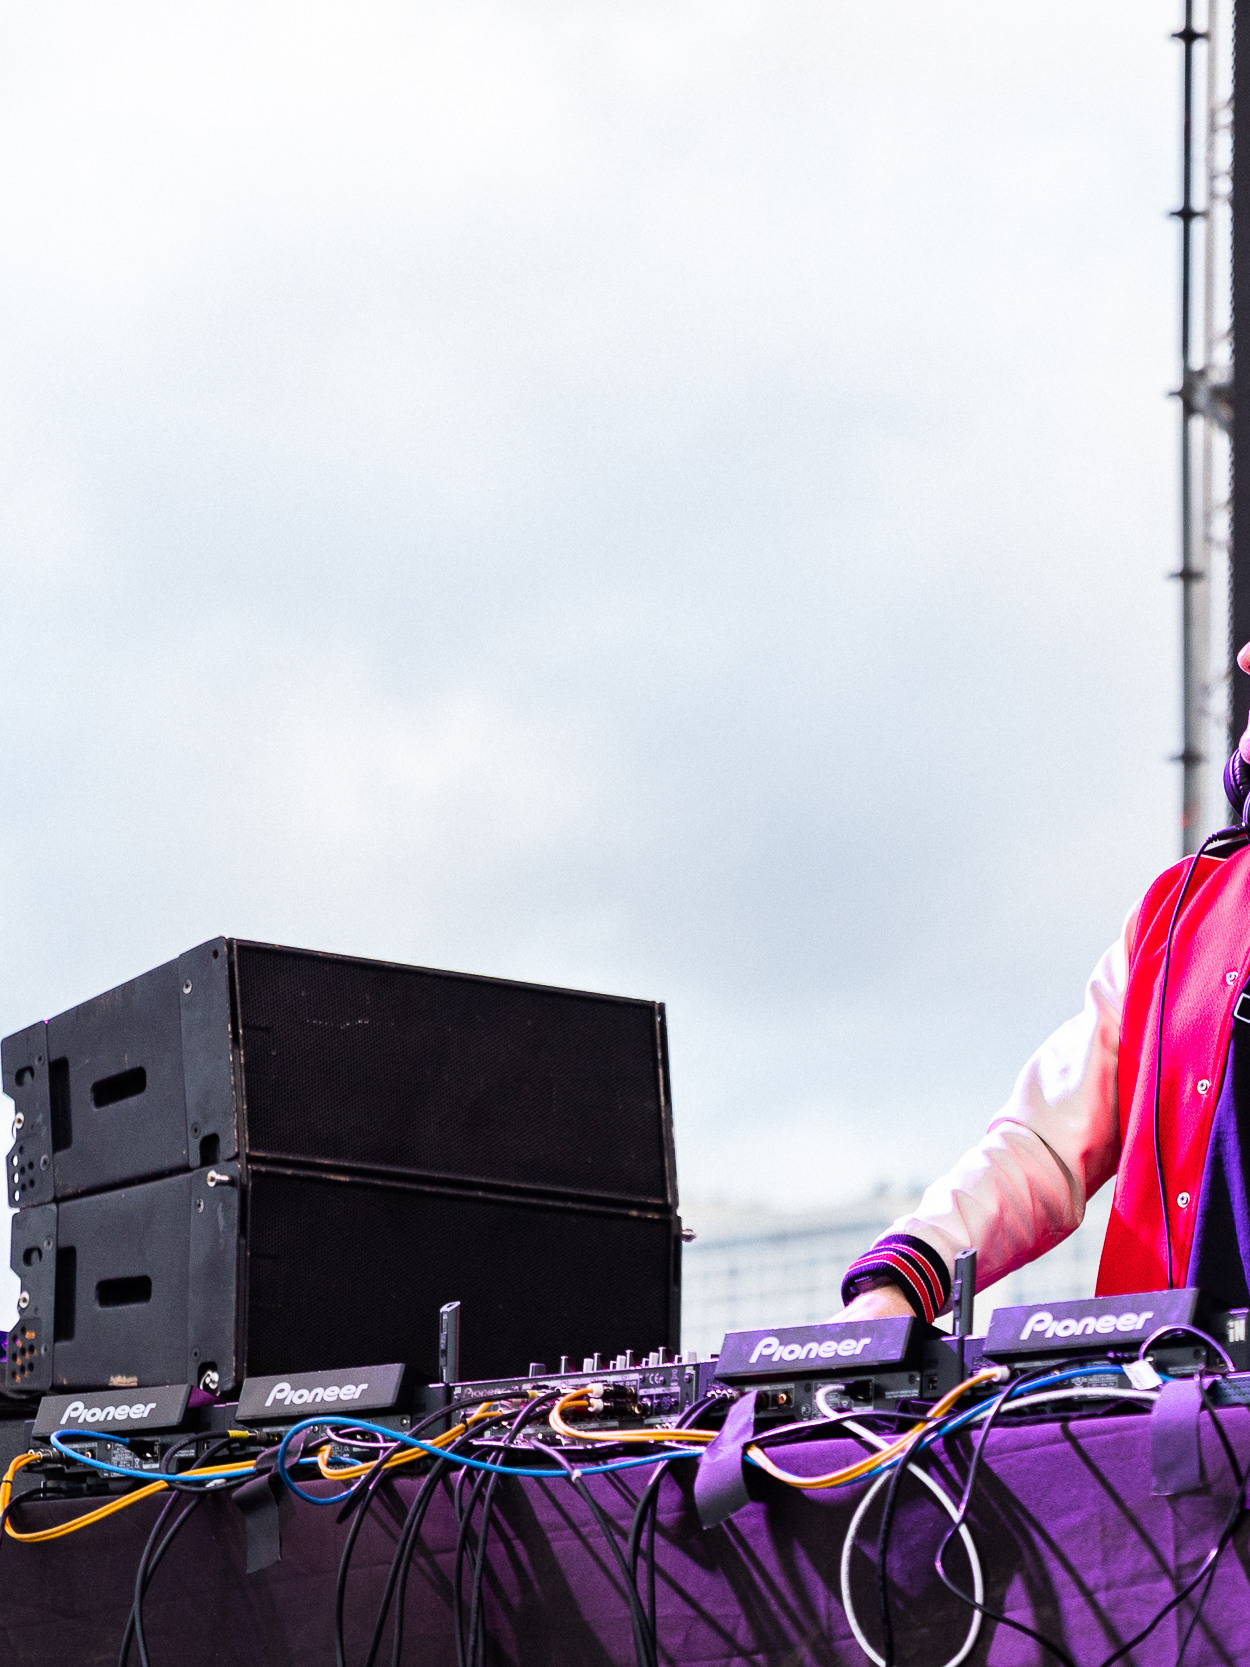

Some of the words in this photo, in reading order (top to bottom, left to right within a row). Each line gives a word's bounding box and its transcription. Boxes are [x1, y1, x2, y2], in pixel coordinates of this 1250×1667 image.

[1018, 1310, 1155, 1341] Pioneer
[748, 1335, 873, 1364] Pioneer
[265, 1381, 369, 1407] Pioneer
[60, 1401, 157, 1425] Pioneer
